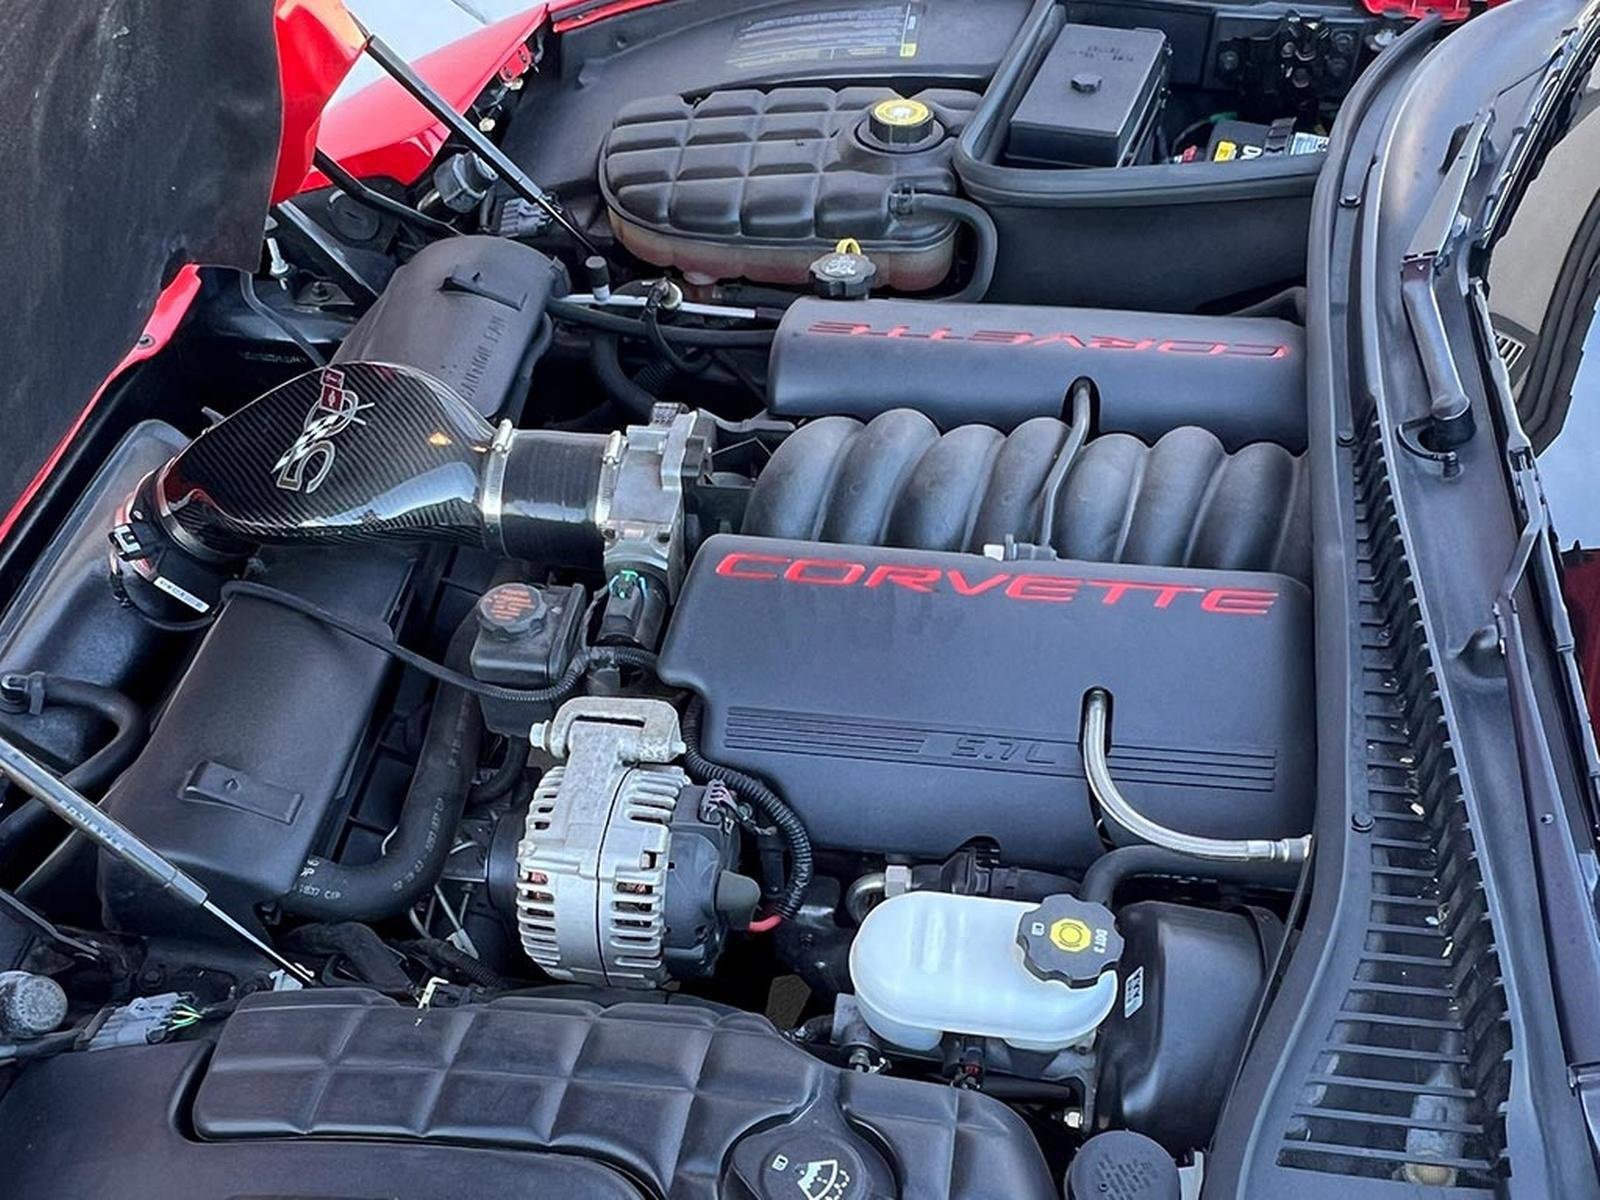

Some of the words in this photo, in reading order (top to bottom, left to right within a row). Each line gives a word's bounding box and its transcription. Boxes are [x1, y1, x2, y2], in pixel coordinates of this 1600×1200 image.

[808, 321, 1291, 360] CORVETTE
[715, 553, 1279, 615] CORVETTE
[951, 737, 1056, 764] 5.7L
[1094, 928, 1108, 947] DOT
